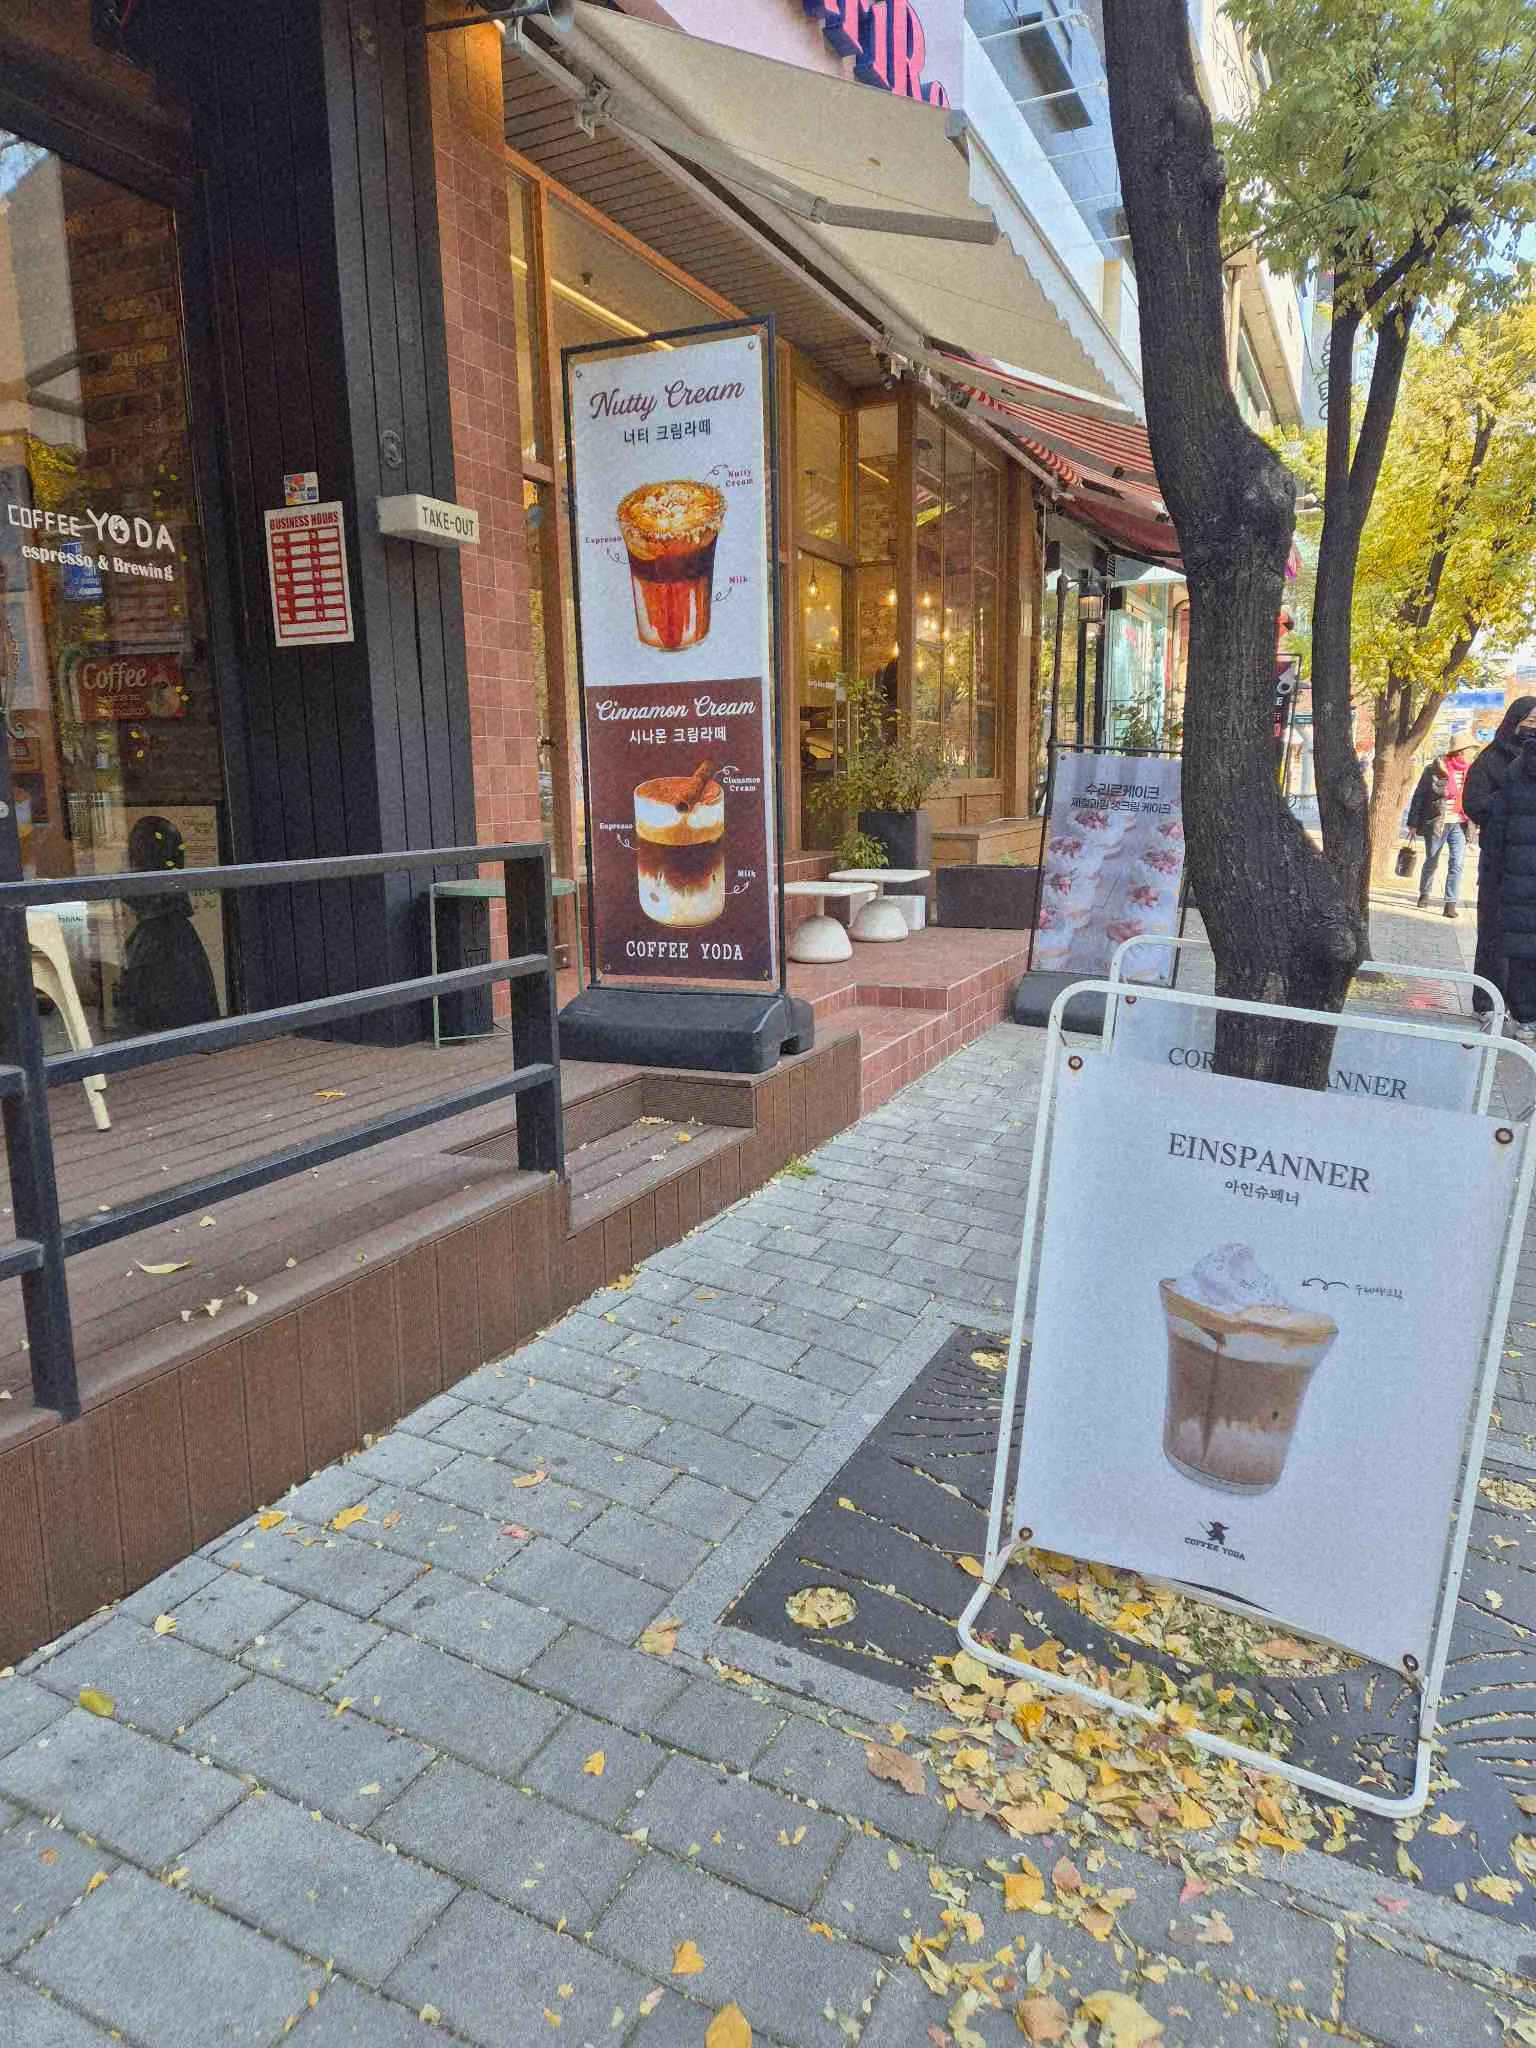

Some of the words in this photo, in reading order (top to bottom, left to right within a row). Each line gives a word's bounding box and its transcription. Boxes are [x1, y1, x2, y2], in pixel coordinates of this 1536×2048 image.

[590, 388, 658, 421] Nutty
[664, 380, 745, 408] Cream
[624, 427, 649, 445] 너티
[656, 418, 712, 440] 크림라떼
[725, 479, 753, 488] Cream
[728, 469, 752, 478] Nutty
[8, 504, 82, 537] COFFEE
[86, 508, 175, 552] YODA
[270, 514, 310, 531] BUSINESS
[310, 511, 339, 527] HOURS
[422, 506, 474, 536] TAKE-OUT
[585, 536, 623, 545] Espresso
[22, 545, 94, 569] espresso
[97, 555, 109, 571] &
[113, 556, 174, 582] Brewing
[729, 576, 749, 584] Milk
[82, 662, 147, 693] Coffee
[595, 700, 688, 721] Cinnamon
[693, 695, 757, 717] Cream
[629, 728, 667, 744] 시나몬
[673, 726, 727, 743] 크림라떼
[723, 776, 761, 784] Cinnamon
[599, 822, 633, 831] Espresso
[737, 869, 757, 878] Milk
[626, 940, 689, 959] COFFEE
[700, 943, 744, 961] YODA
[1168, 1132, 1371, 1193] EINSPANNER
[1225, 1179, 1300, 1206] 아인슈페너
[1184, 1536, 1220, 1552] COFFEE
[1222, 1547, 1246, 1561] YODA
